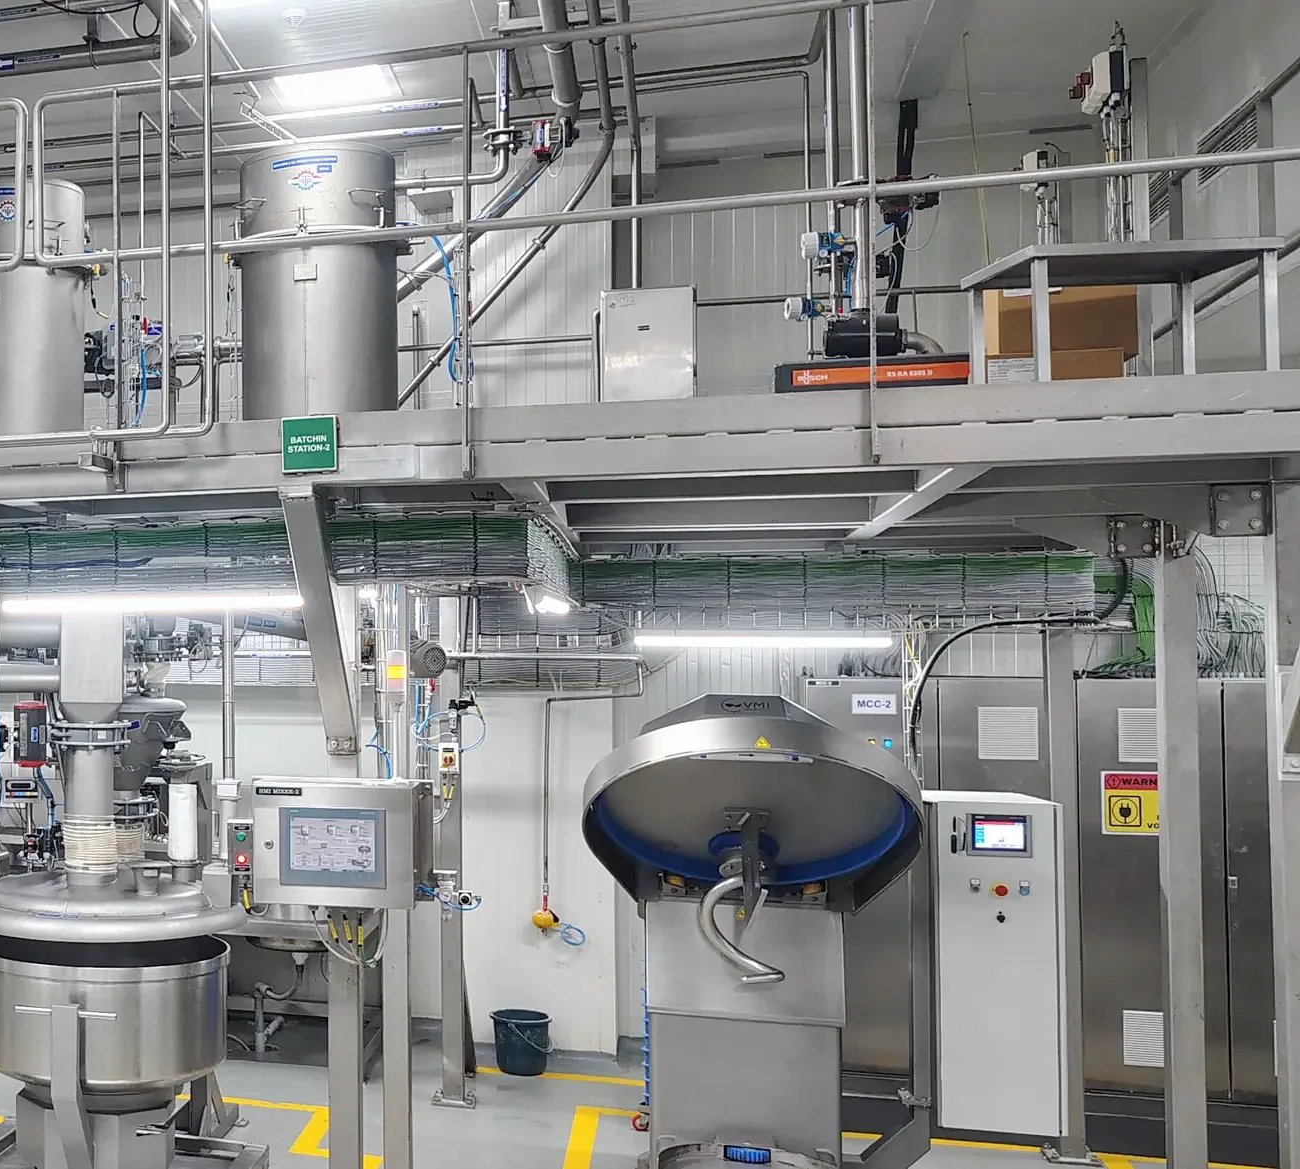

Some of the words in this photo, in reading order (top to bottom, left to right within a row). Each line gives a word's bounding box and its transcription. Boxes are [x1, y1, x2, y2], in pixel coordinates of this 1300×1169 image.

[797, 370, 828, 385] BUSCH
[290, 434, 327, 444] BATCHIN
[287, 443, 331, 454] STATION-2
[743, 701, 770, 709] VMI
[857, 699, 892, 709] MCC-2
[1121, 778, 1158, 786] WARN
